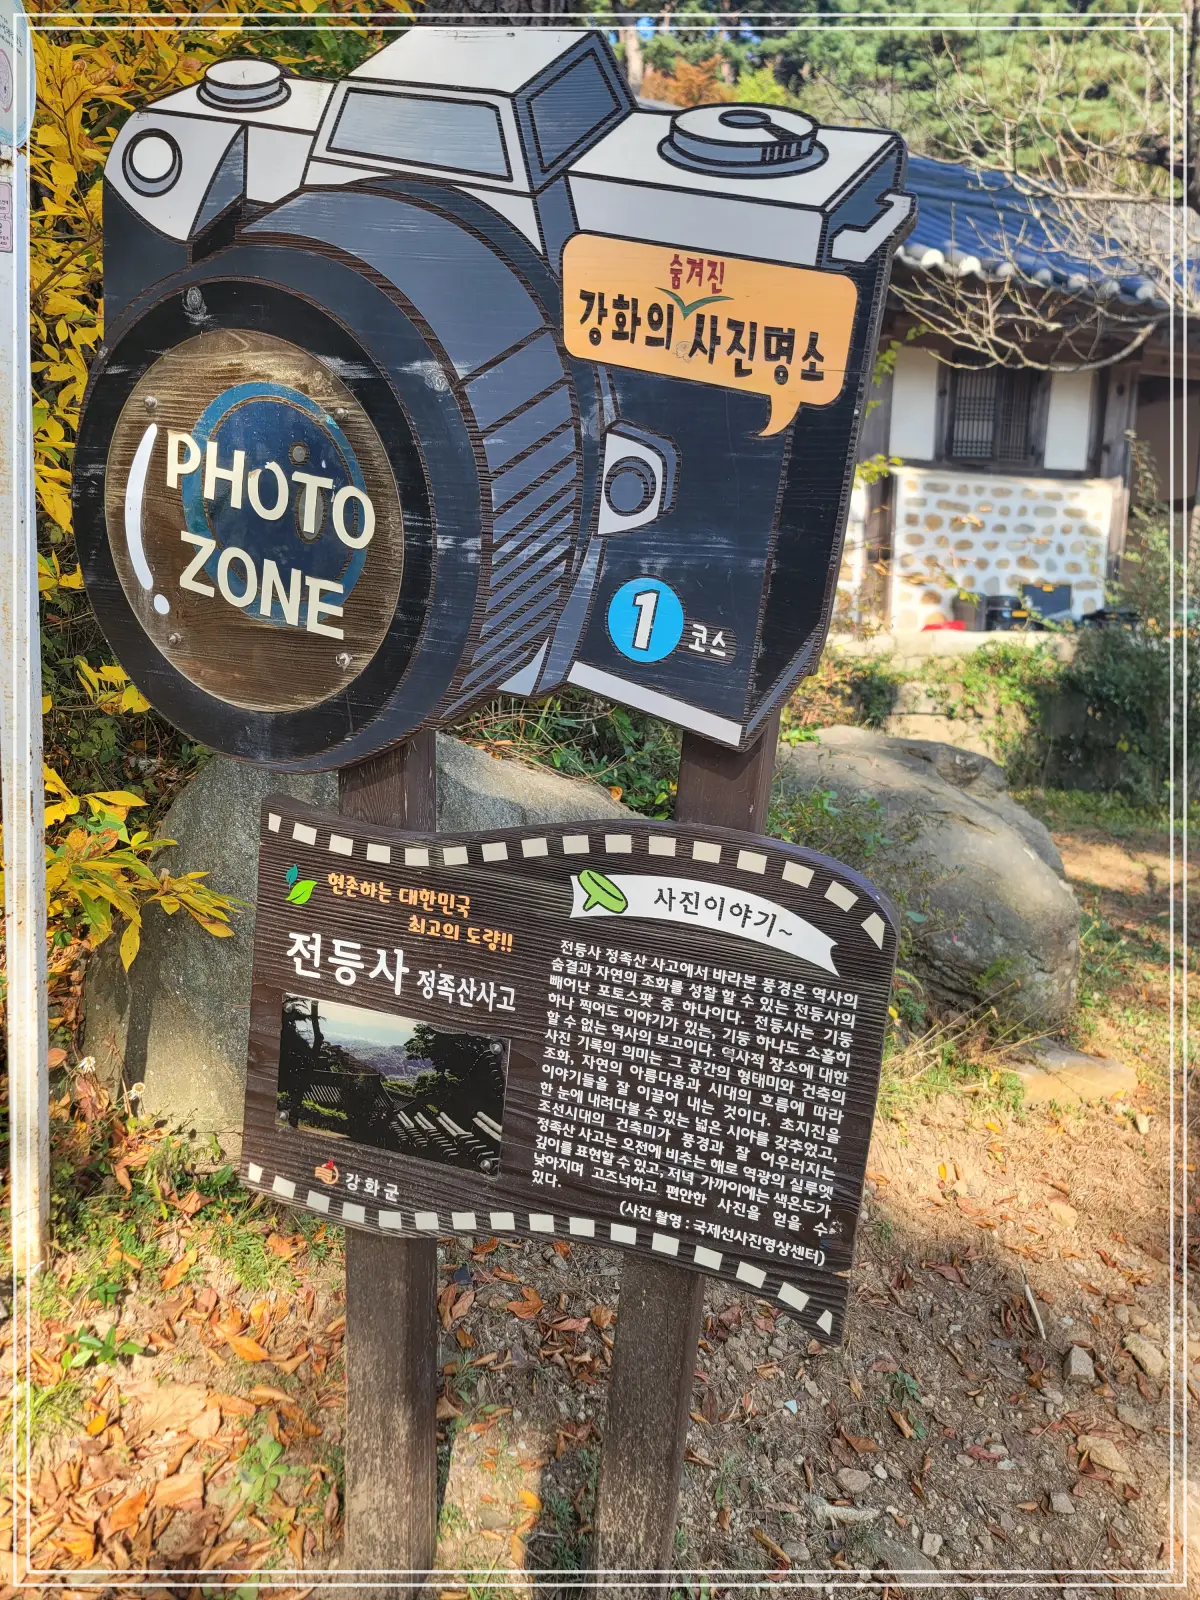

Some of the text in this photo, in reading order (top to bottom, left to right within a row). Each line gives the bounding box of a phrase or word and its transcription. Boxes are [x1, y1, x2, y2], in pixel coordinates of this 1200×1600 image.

[670, 253, 725, 294] 숨겨진
[579, 289, 825, 386] 강화의 사진명소
[166, 429, 376, 549] PHOTO
[179, 530, 344, 640] ZONE
[632, 589, 726, 657] 1 코스
[327, 872, 471, 918] 현존하는 대한민국
[407, 914, 513, 953] 최고의 도량!!
[286, 932, 516, 1013] 전등사 정족산사고
[549, 974, 853, 1048] 빼어난 포토스팟 중 하나이다. 전등사는 기둥
[550, 957, 856, 1029] 숨결과 자연의 조화를 성찰 할 수 있는 전등사의
[560, 939, 858, 1010] 전등사 정족산 사고에서 바라본 풍경은 역사의
[543, 1028, 846, 1106] 사진 기록의 의미는 그 공간의 형태미와 건축의
[546, 1009, 849, 1087] 할 수 없는 역사의 보고이다. 역사적 장소에 대한
[547, 992, 851, 1068] 하나 찍어도 이야기가 있는, 기둥 하나도 소홀히
[539, 1081, 837, 1163] 한 눈에 내려다볼 수 있는 넓은 시야를 갖추었고,
[541, 1063, 841, 1144] 이야기들을 잘 이끌어 내는 것이다. 초지진을
[542, 1046, 844, 1125] 조화, 자연의 아름다움과 시대의 흐름에 따라
[531, 1169, 561, 1188] 있다.
[535, 1134, 831, 1219] 깊이를 표현할 수 있고, 저녁 가까이에는 색온도가
[536, 1116, 834, 1201] 정족산 사고는 오전에 비추는 해로 역광의 실루엣
[537, 1098, 836, 1181] 조선시대의 건축미가 풍경과 잘 어우러지는
[533, 1151, 828, 1237] 낮아지며 고즈넉하고 편안한 사진을 얻을 수
[619, 1200, 652, 1221] (사진
[654, 1209, 682, 1229] 촬영
[692, 1219, 825, 1267] 국제선사진영상센터)
